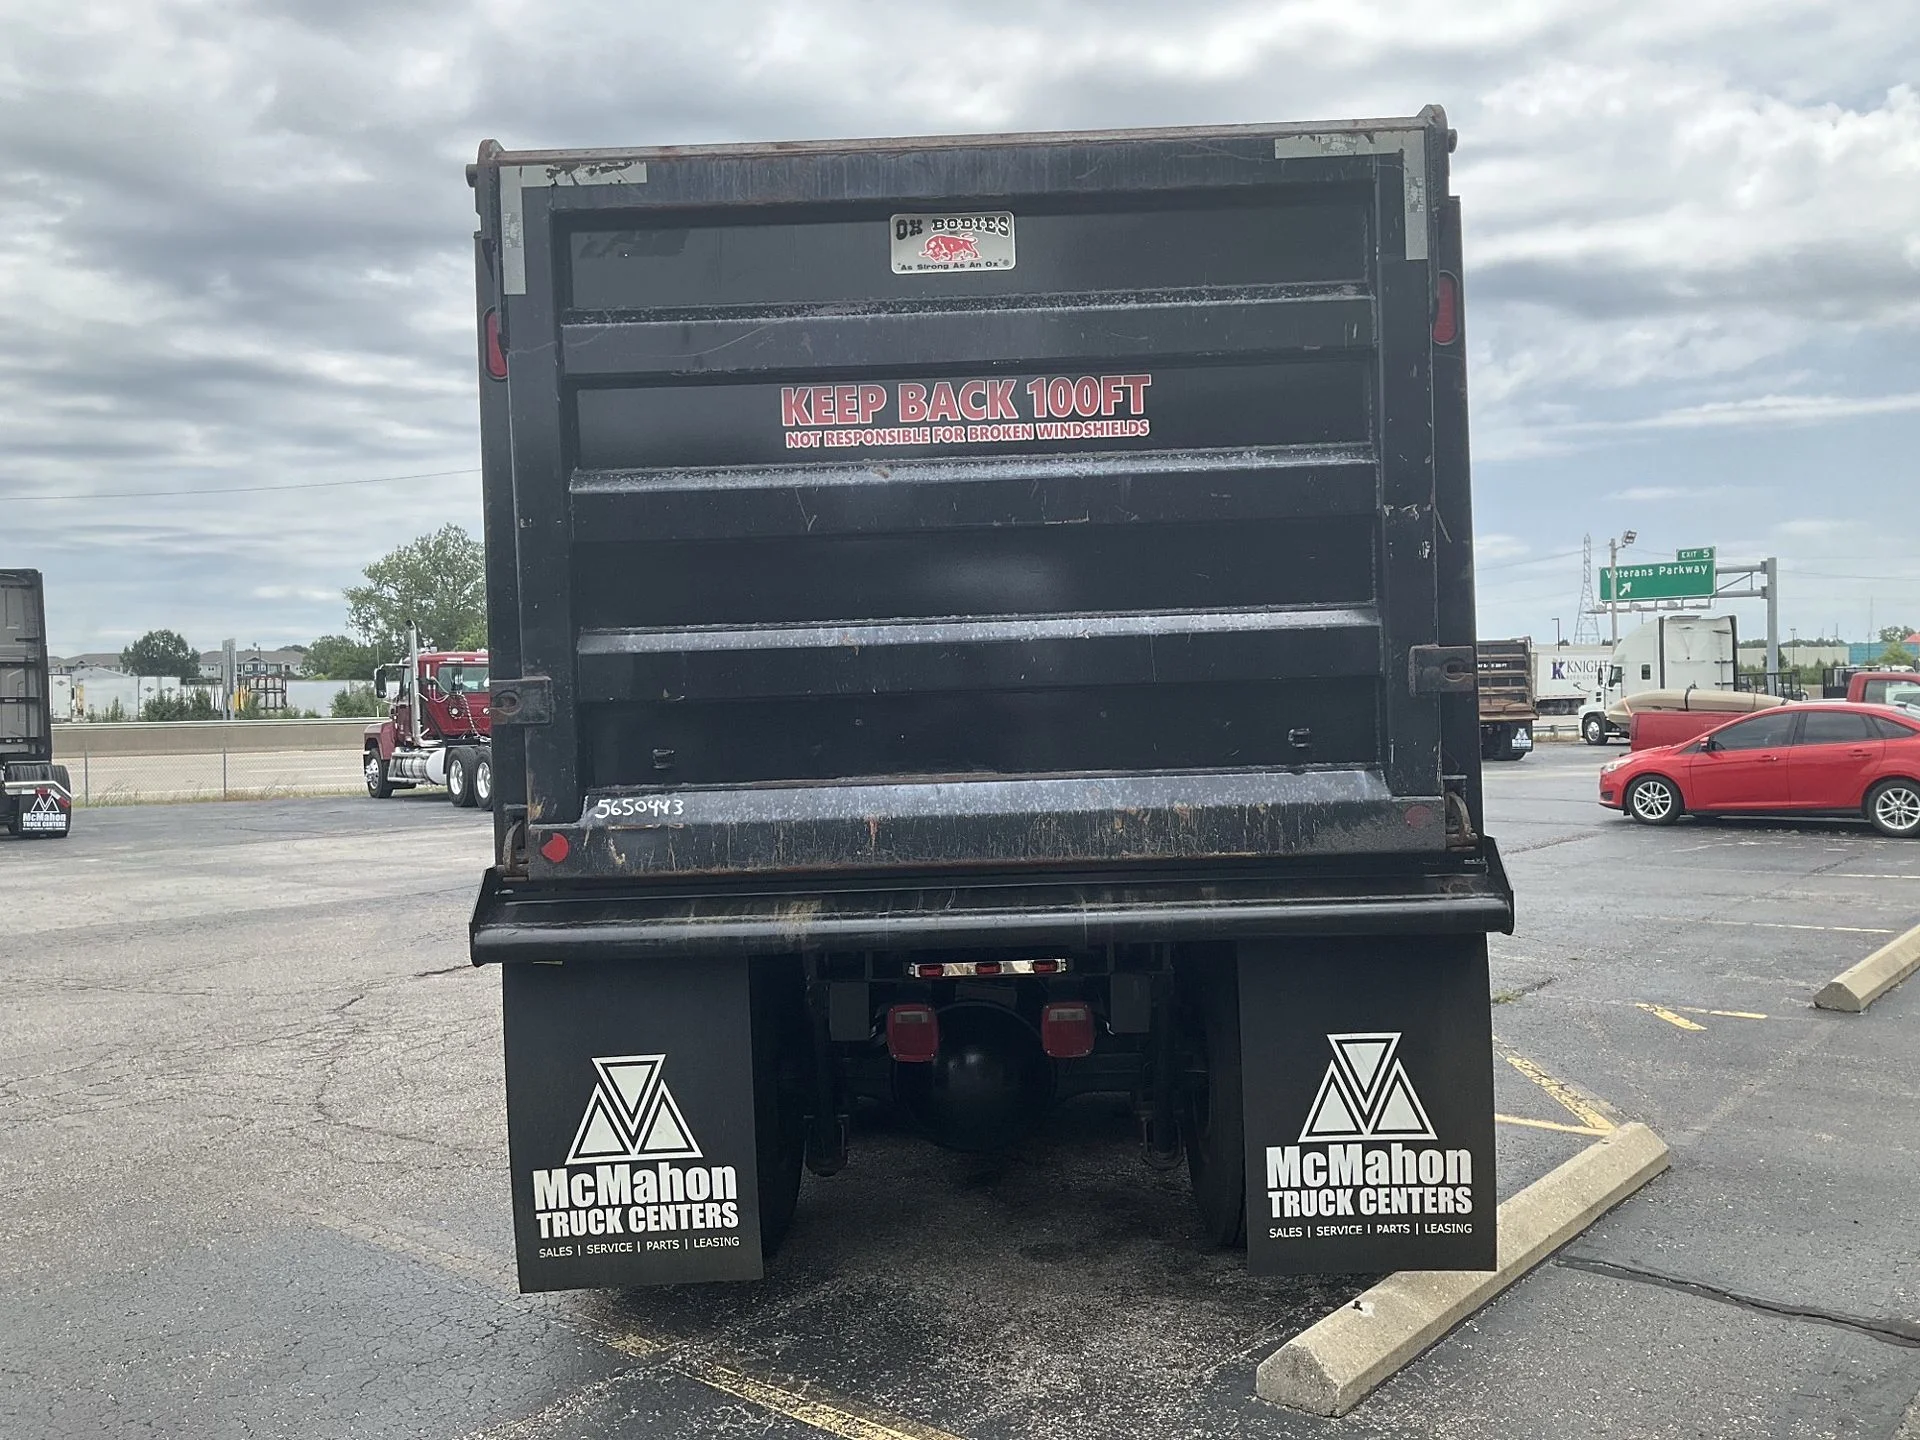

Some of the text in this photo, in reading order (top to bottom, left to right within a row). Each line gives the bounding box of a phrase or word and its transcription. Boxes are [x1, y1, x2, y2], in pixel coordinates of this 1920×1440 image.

[896, 217, 1011, 240] OX BODIES
[953, 261, 965, 269] As
[781, 374, 1151, 426] KEEP BACK 100FT
[785, 419, 1150, 448] NOT RESPONSIBLE FOR BROKEN WINDSHIELDS
[1681, 549, 1710, 559] EXIT 5
[1659, 564, 1708, 576] Parkway
[1567, 659, 1609, 673] KNIGHT
[22, 812, 66, 822] McMahon
[595, 798, 684, 819] 5650443
[1265, 1142, 1473, 1189] McMahon
[532, 1162, 738, 1211] McMahon
[1267, 1186, 1473, 1218] TRUCK CENTERS
[536, 1202, 739, 1239] TRUCK CENTERS
[1269, 1222, 1473, 1239] SALES SERVICE PARTS LEASING
[539, 1236, 740, 1258] SALES SERVICE PARTS LEASING
